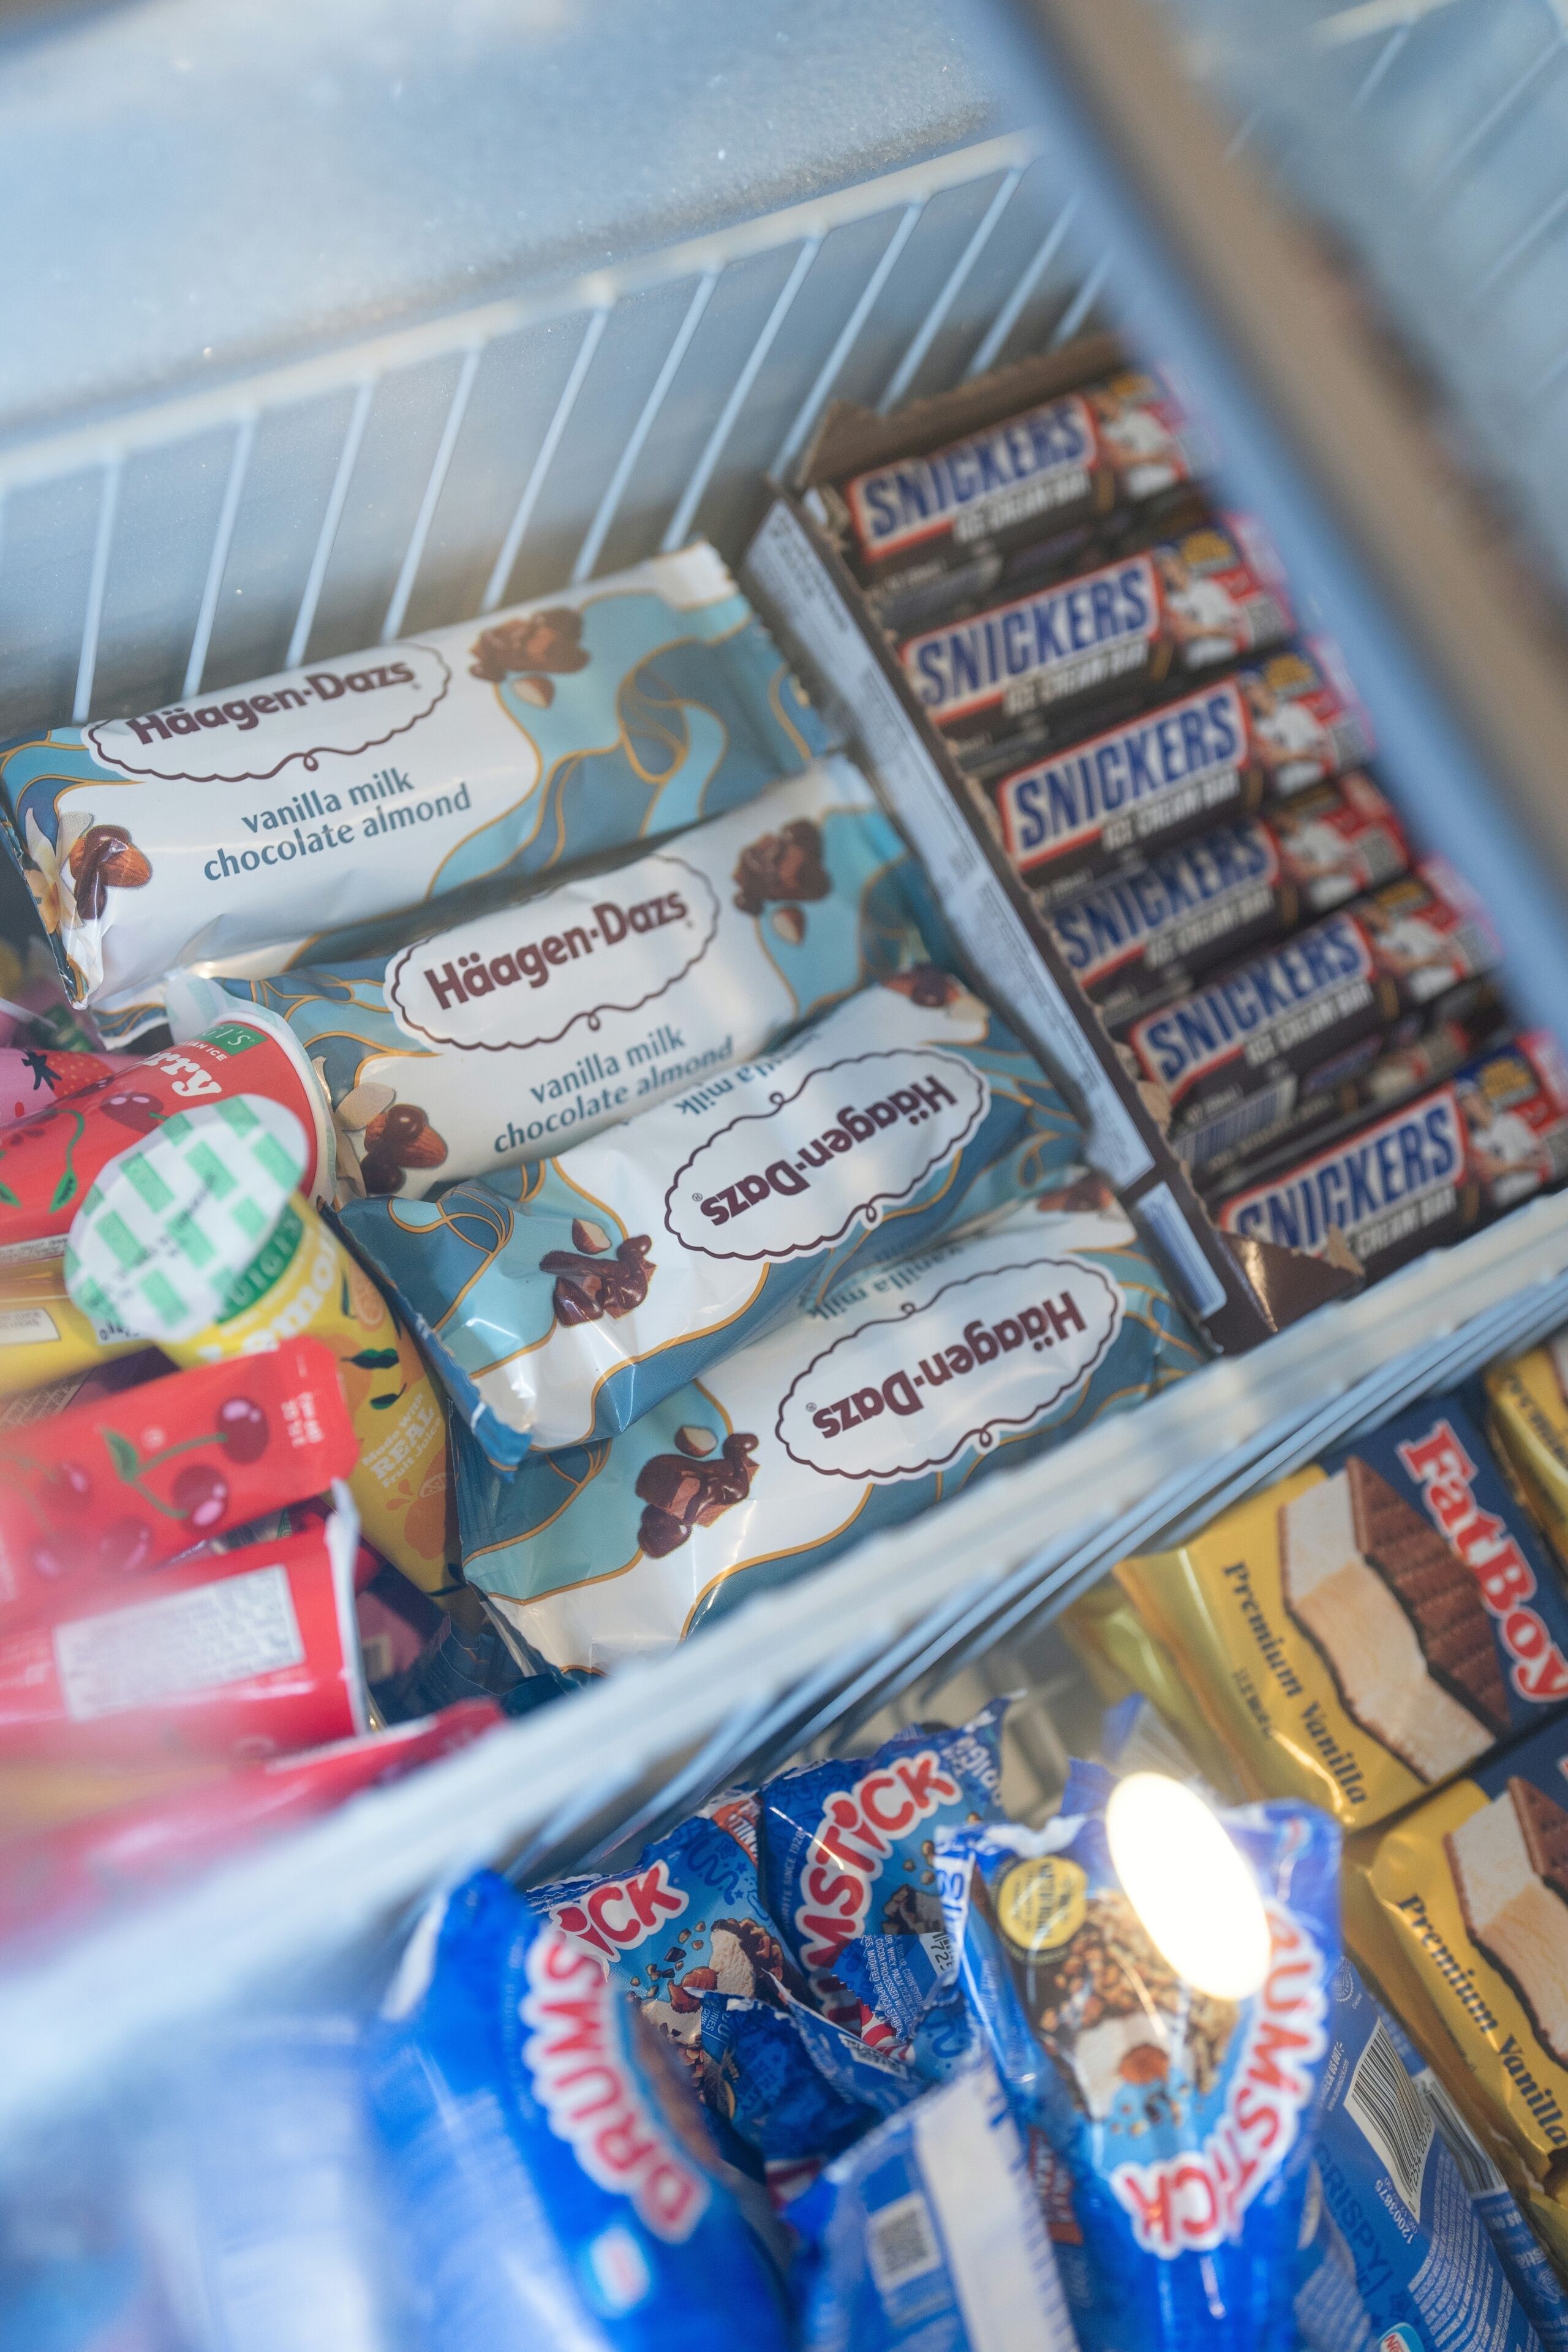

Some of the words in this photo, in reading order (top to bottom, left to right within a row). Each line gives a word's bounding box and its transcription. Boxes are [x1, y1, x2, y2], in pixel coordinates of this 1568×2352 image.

[865, 401, 1085, 538] SNICKERS
[918, 568, 1148, 706] SNICKERS
[124, 661, 415, 745] Häagen-Dazs
[241, 789, 343, 834] vanilla
[348, 767, 415, 807] milk
[1014, 695, 1235, 850] SNICKERS
[204, 822, 355, 881] chocolate
[364, 781, 471, 838] almond
[1053, 824, 1267, 969] SNICKERS
[423, 890, 688, 1010] Häagen-Dazs
[1147, 923, 1361, 1080] SNICKERS
[141, 1052, 222, 1097] rry
[205, 1047, 228, 1061] ICE
[494, 1080, 630, 1153] chocolate
[636, 1034, 733, 1097] almond
[530, 1052, 620, 1104] vanilla
[627, 1023, 685, 1067] milk
[676, 1075, 736, 1116] milk
[699, 1075, 959, 1226] Häagen-Dazs
[812, 1292, 1088, 1439] Häagen-Dazs
[369, 1406, 435, 1480] REAL
[416, 1416, 442, 1458] Juice
[1398, 1419, 1568, 1702] FatBoy
[1223, 1561, 1305, 1698] Premium
[1299, 1699, 1370, 1806] Vanilla
[867, 1949, 881, 1982] MODIFIED
[874, 1981, 892, 2013] TAPIOCA
[875, 1938, 886, 1961] COCOA
[880, 1960, 900, 2000] PROCESSED
[887, 1946, 897, 1969] WHEY,
[891, 1968, 905, 1988] PALM
[895, 1943, 907, 1969] SUGAR,
[902, 1968, 917, 1988] CORN
[894, 1999, 907, 2016] WITH
[1398, 1894, 1498, 2034] Premium
[1498, 2034, 1568, 2146] Vanilla
